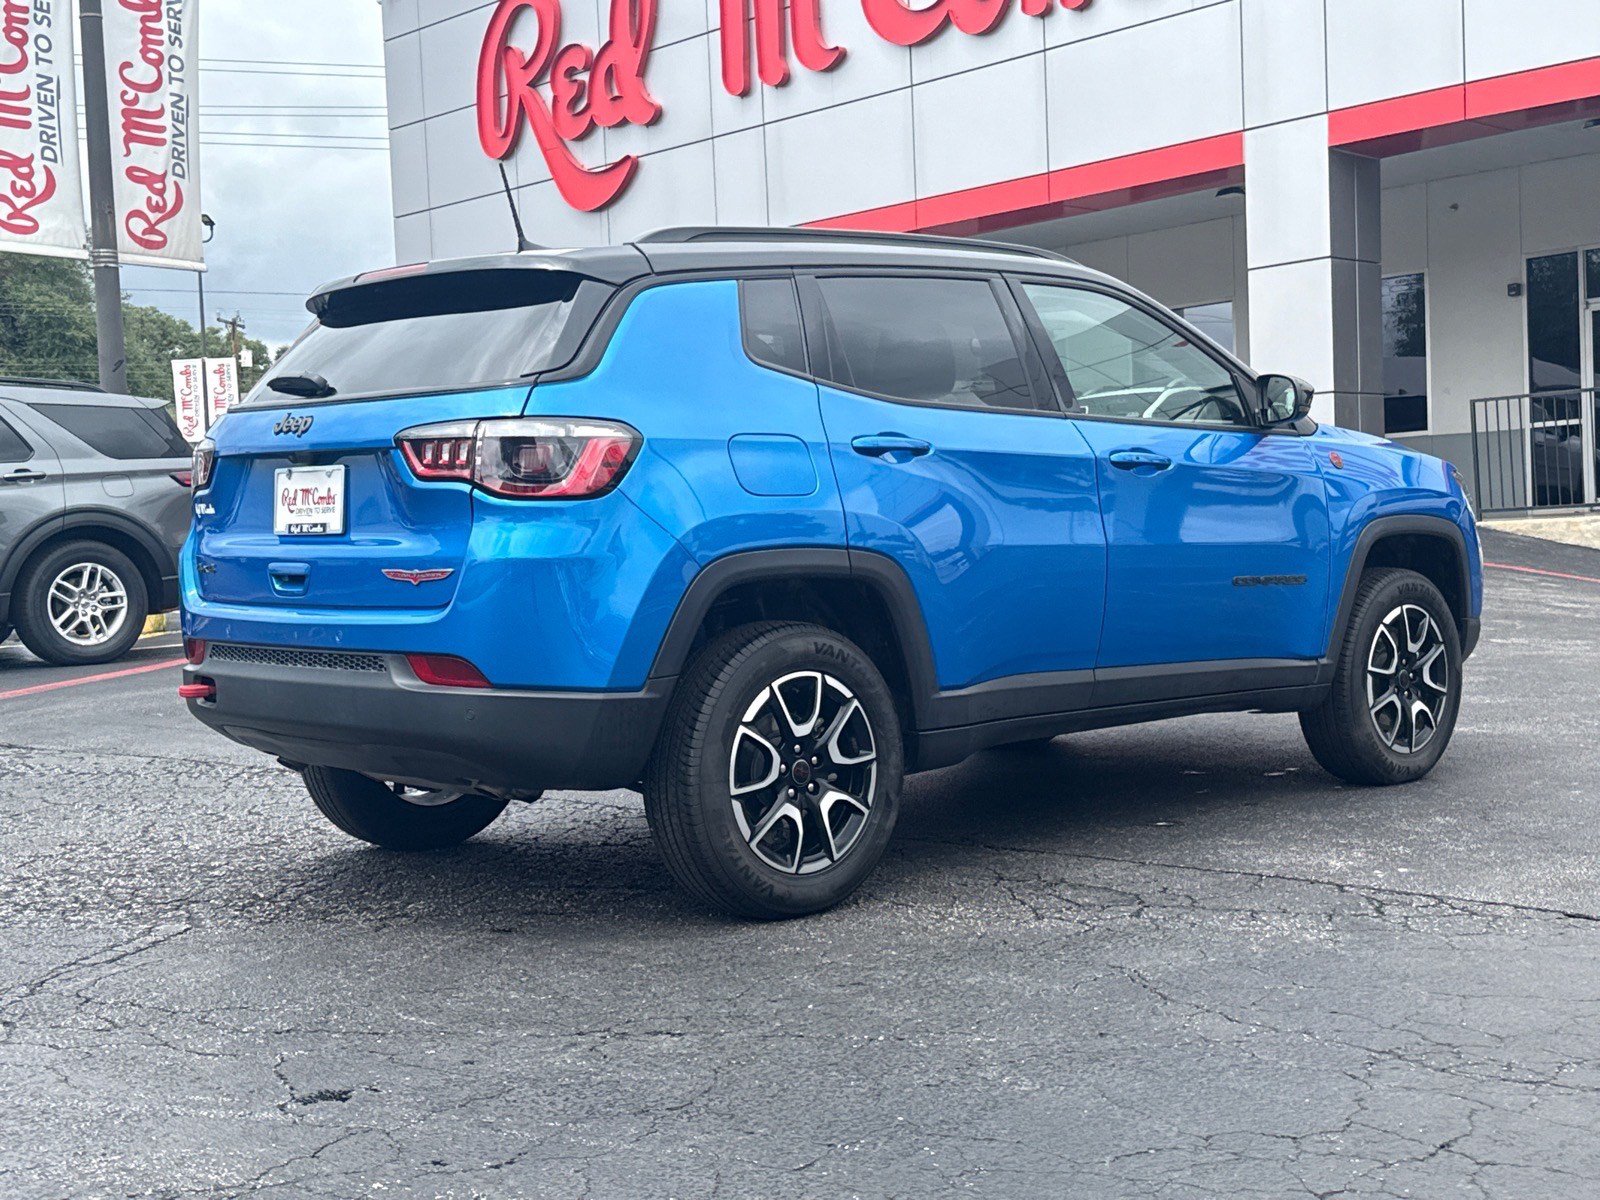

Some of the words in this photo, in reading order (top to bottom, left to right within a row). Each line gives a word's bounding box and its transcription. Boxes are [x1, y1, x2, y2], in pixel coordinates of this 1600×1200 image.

[0, 0, 33, 130] MCom
[34, 34, 53, 66] TO
[168, 54, 185, 85] TO
[36, 73, 58, 164] DRIVEN
[476, 0, 663, 213] Red
[169, 92, 186, 180] DRIVEN
[0, 150, 57, 235] Red
[125, 165, 184, 250] Red
[179, 364, 194, 413] McCombs
[213, 363, 227, 410] McCombs
[182, 415, 199, 437] Red
[273, 412, 314, 438] Jeep
[281, 487, 298, 514] Red
[299, 486, 337, 507] McCombs
